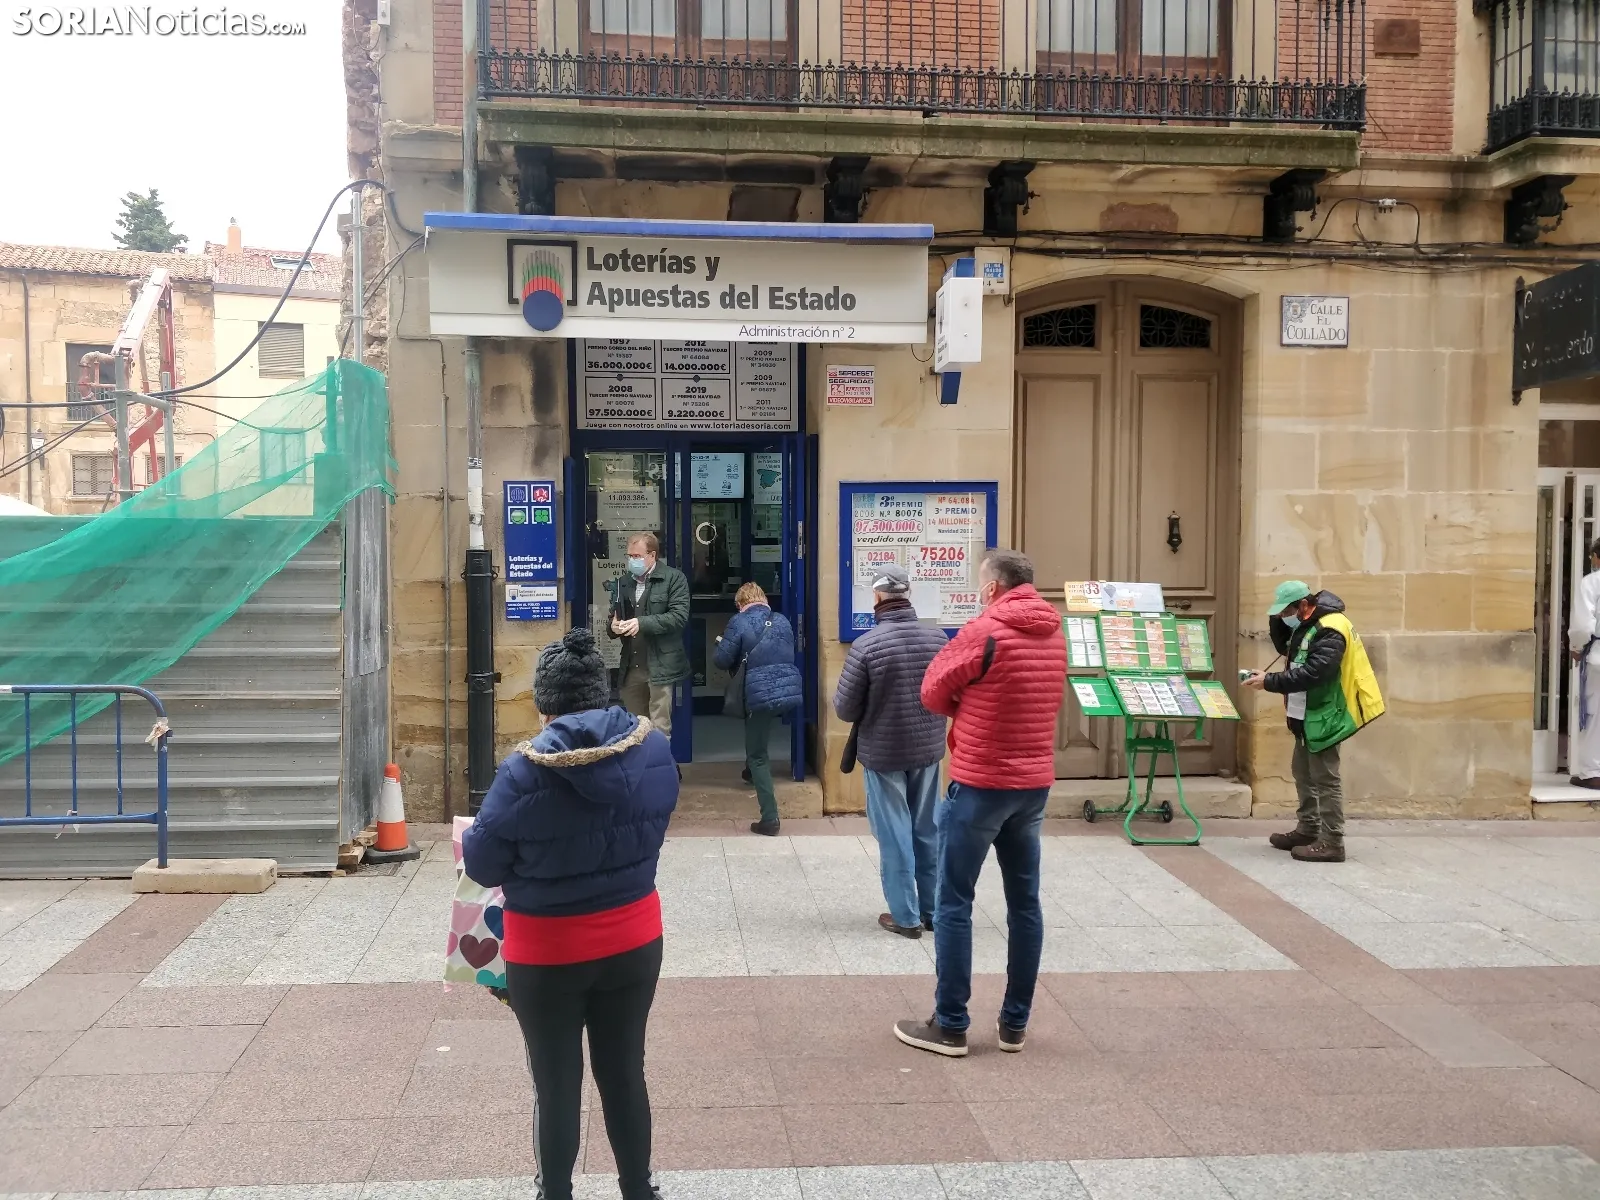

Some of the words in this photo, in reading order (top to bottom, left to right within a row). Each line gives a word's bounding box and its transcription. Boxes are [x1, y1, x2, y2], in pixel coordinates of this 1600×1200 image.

[586, 246, 697, 275] Loterías
[705, 256, 721, 282] y
[586, 281, 711, 313] Apuestas
[719, 284, 760, 311] del
[768, 286, 857, 312] Estado
[1310, 303, 1343, 315] CALLE
[1316, 315, 1331, 325] EL
[738, 324, 830, 339] Administración
[847, 327, 856, 339] 2
[1286, 324, 1346, 341] COLLADO
[587, 361, 653, 370] 36.000.000€
[664, 362, 727, 371] 14.000.000€
[608, 385, 633, 393] 2008
[685, 386, 707, 394] 2019
[588, 408, 653, 417] 97.500.000€
[667, 410, 725, 418] 9.220.000€
[690, 422, 791, 430] www.loteriadesoria.com
[948, 496, 975, 505] 64.084
[895, 509, 923, 518] 80076
[945, 507, 977, 515] PREMIO
[928, 518, 936, 526] 14
[938, 517, 971, 526] MILLONES
[856, 535, 895, 544] vendido
[867, 551, 896, 562] 02184
[920, 546, 965, 561] 75206
[538, 555, 543, 563] y
[509, 563, 541, 571] Apuestas
[930, 560, 961, 568] PREMIO
[916, 568, 953, 577] 9.222.000
[1084, 583, 1101, 595] 33
